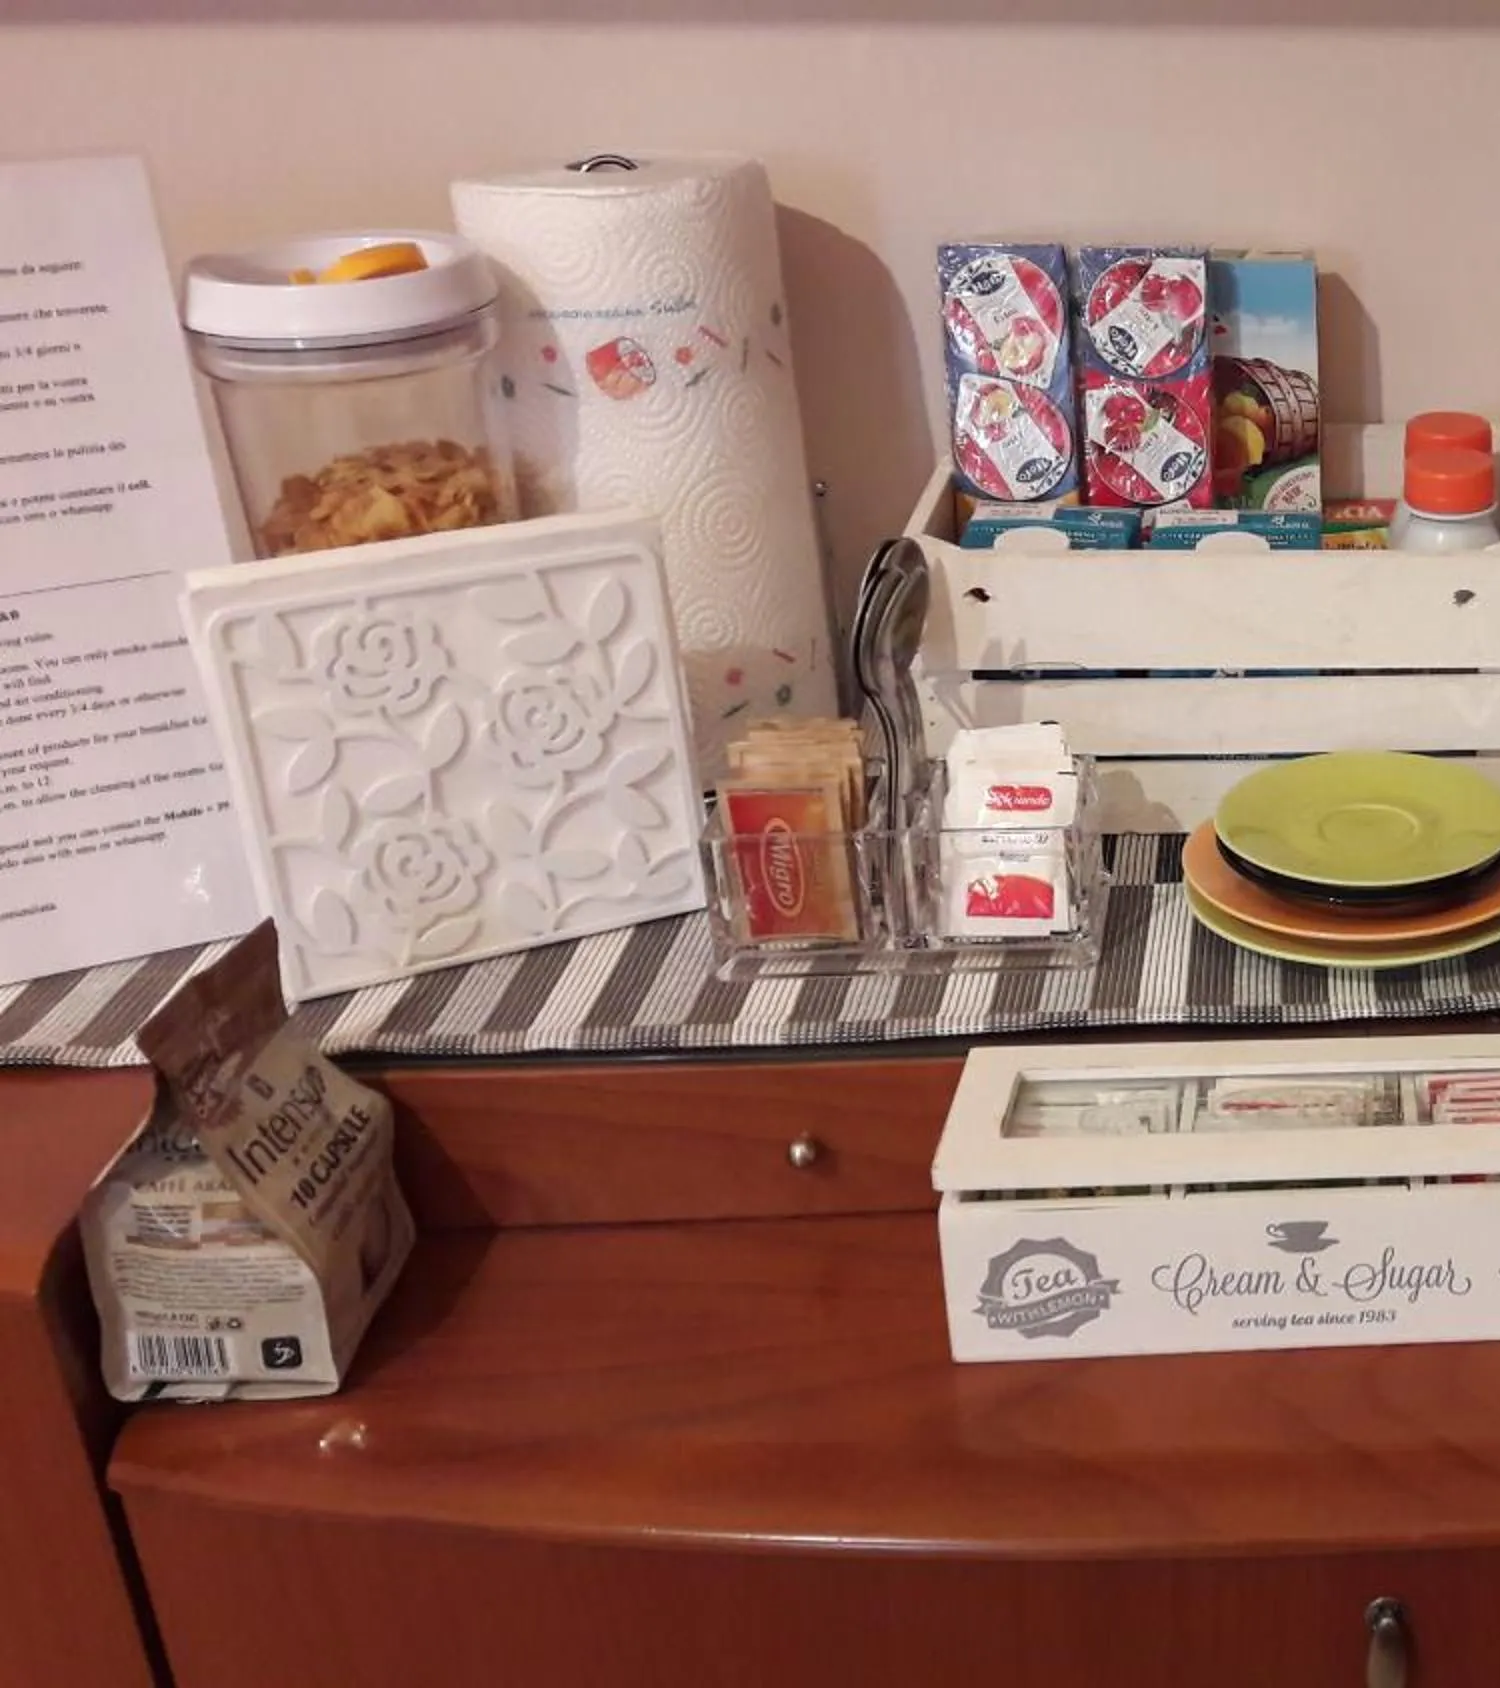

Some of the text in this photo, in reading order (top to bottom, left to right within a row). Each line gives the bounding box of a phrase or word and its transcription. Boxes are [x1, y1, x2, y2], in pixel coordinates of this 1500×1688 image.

[1011, 1268, 1079, 1300] Tea
[1151, 1245, 1473, 1316] Cream & Sugar
[1231, 1308, 1398, 1330] serving tea since 1983
